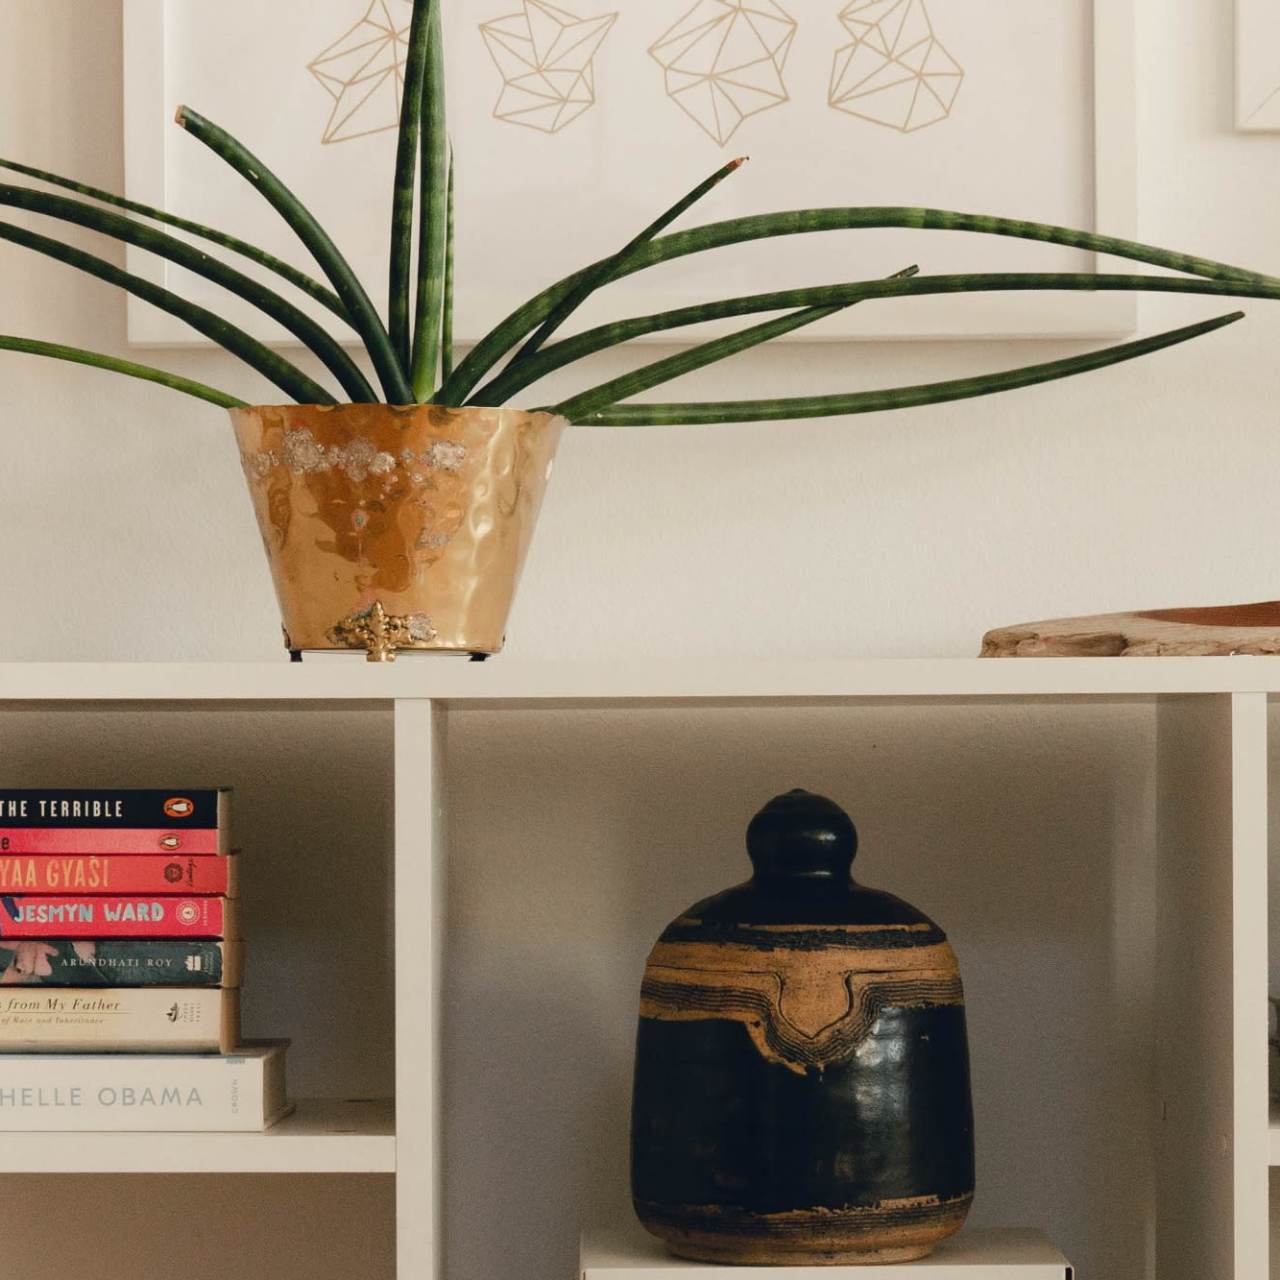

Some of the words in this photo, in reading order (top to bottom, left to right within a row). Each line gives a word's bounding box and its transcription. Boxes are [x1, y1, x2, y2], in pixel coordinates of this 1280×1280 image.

[40, 800, 123, 817] TERRIBLE
[0, 859, 37, 887] YAA
[14, 904, 93, 922] JESMYN
[104, 903, 164, 922] WARD
[5, 998, 41, 1012] from
[46, 998, 67, 1012] My
[71, 998, 121, 1010] Father
[97, 1087, 203, 1107] OBAMA
